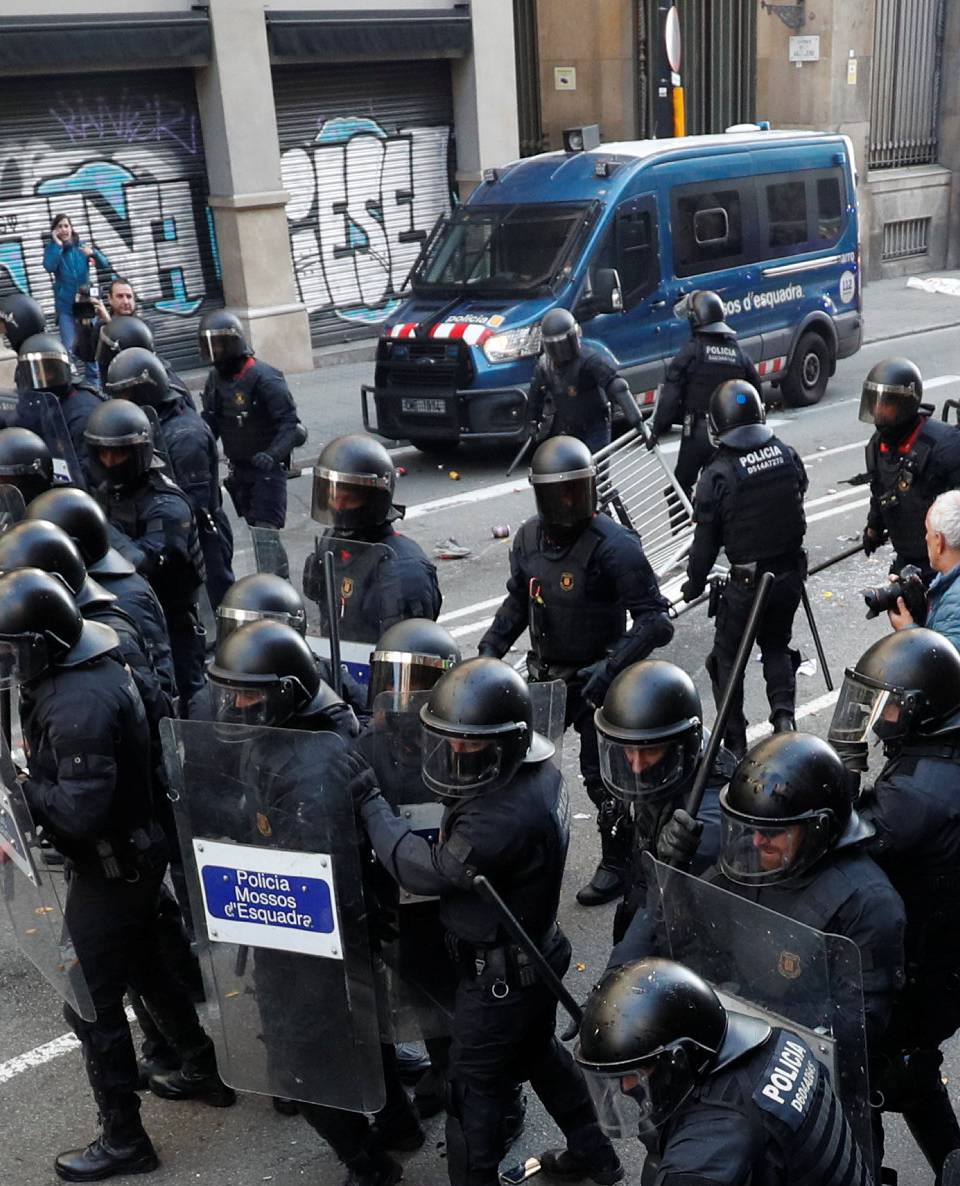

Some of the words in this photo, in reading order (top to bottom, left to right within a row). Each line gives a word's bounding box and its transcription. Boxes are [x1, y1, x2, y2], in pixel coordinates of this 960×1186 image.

[743, 282, 802, 312] d'esquadra
[445, 314, 488, 323] policia
[706, 345, 737, 356] POLICIA
[739, 445, 782, 468] POLICIA
[236, 870, 291, 891] Policia
[235, 885, 297, 908] Mossos
[224, 902, 312, 927] d'Esquadra
[762, 1040, 806, 1104] POLICIA
